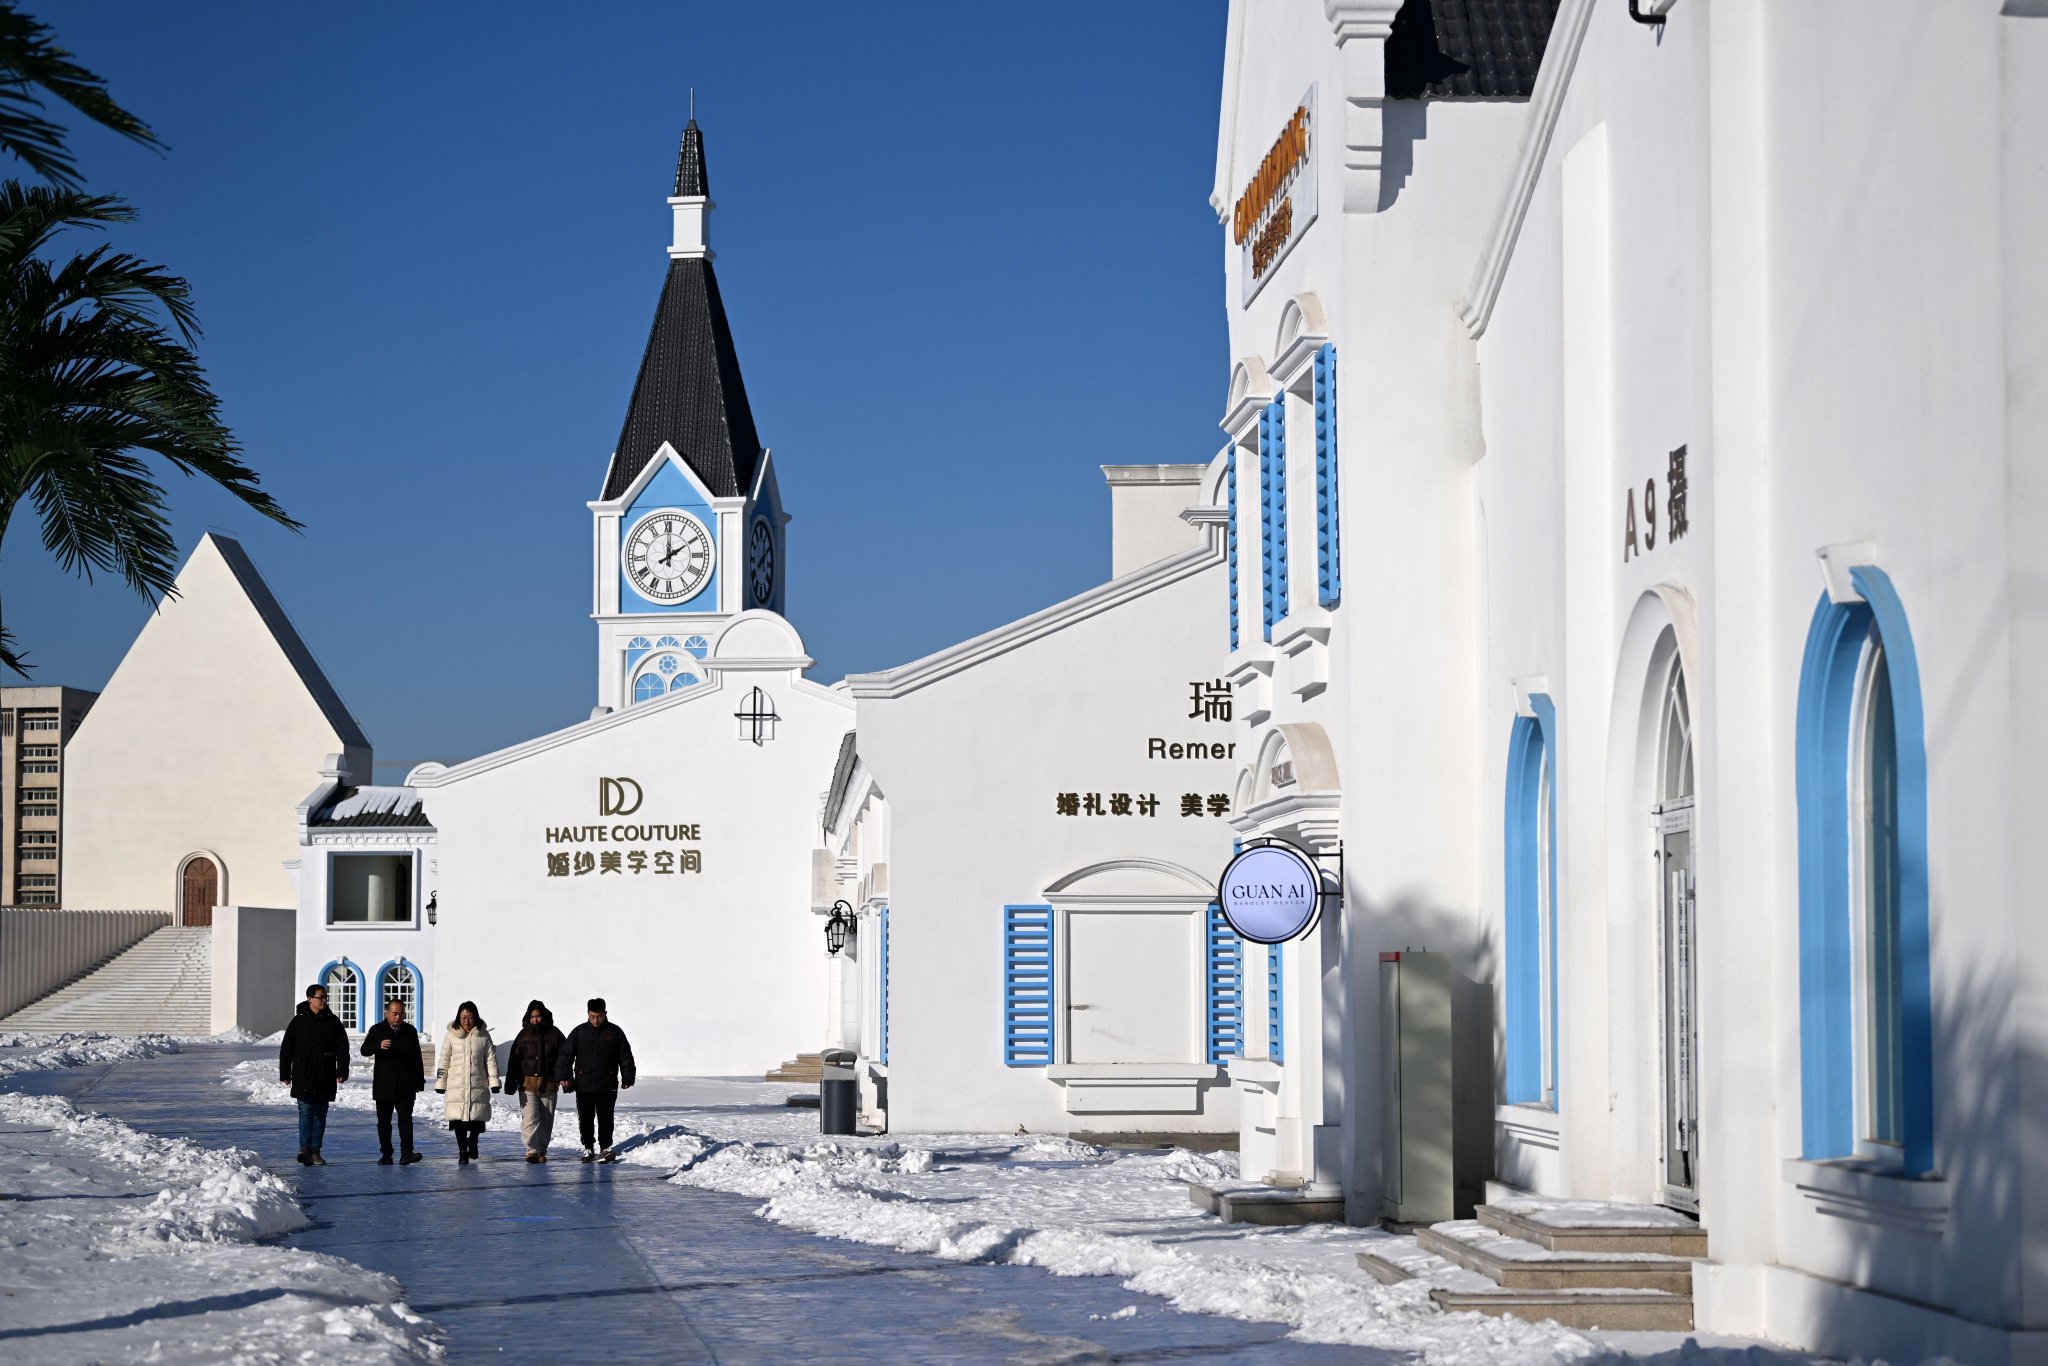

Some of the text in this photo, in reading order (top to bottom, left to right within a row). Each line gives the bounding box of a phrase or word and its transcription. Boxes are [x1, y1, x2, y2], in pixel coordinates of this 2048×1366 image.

[1188, 678, 1233, 722] 瑞
[1056, 792, 1231, 818] 婚礼设计 美学
[546, 824, 701, 843] HAUTE COUTURE
[547, 849, 702, 877] 婚纱美学空间
[1232, 884, 1304, 899] GUAN AI
